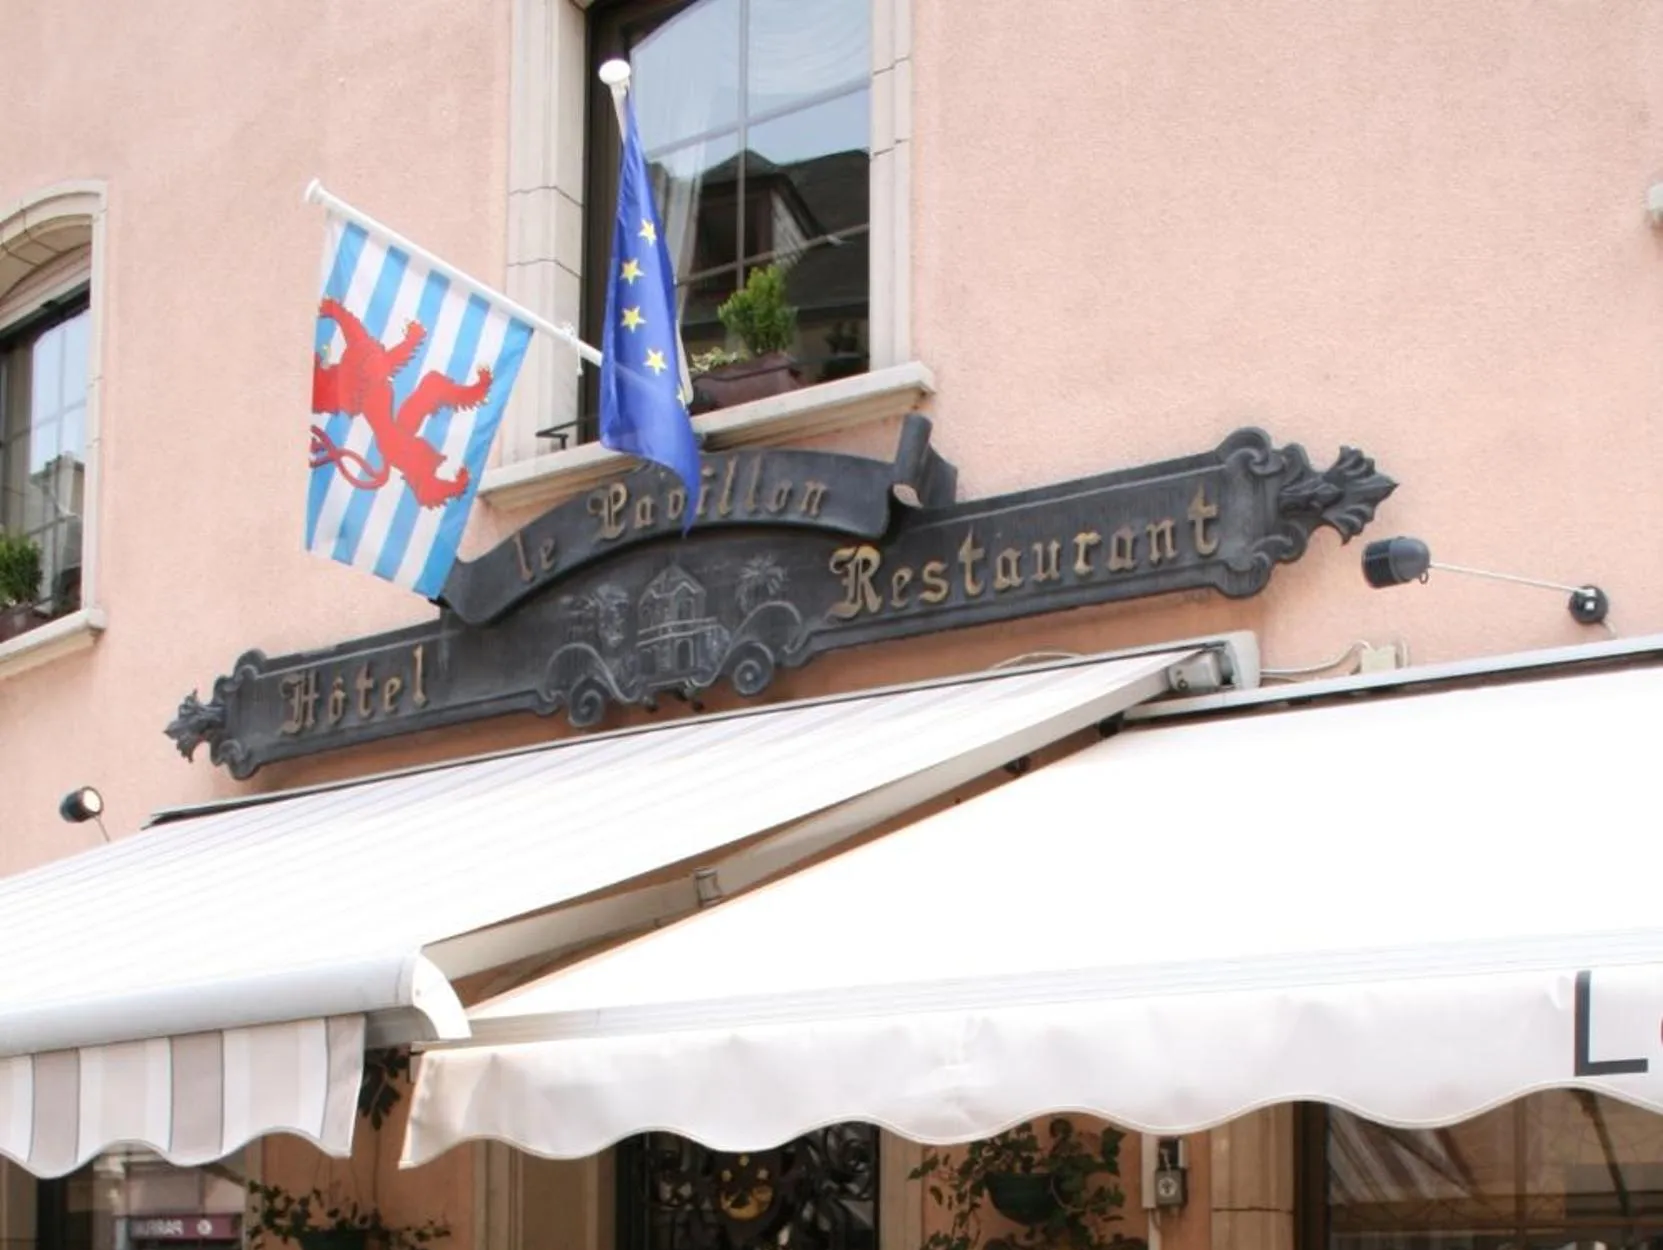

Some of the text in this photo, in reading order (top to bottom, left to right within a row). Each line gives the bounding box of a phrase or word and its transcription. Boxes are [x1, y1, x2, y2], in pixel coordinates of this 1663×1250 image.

[829, 489, 1218, 619] Restaurant
[279, 643, 427, 733] Hôtel
[1574, 970, 1663, 1076] L
